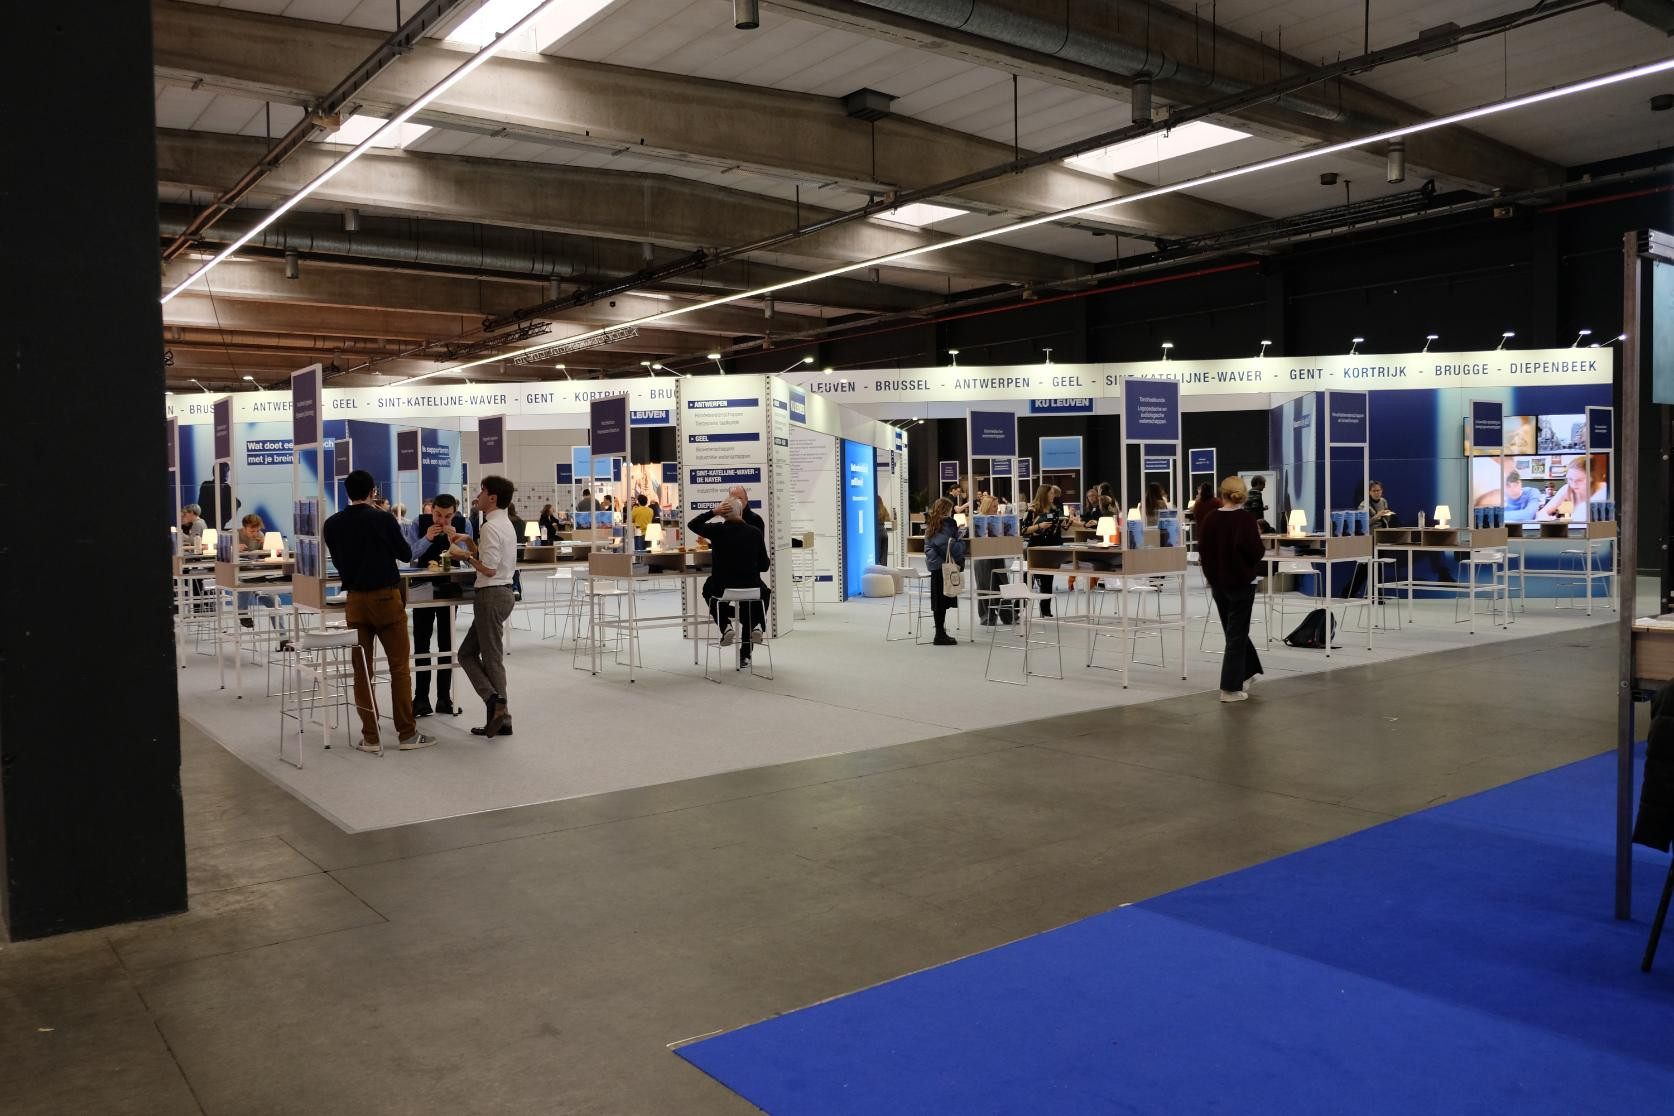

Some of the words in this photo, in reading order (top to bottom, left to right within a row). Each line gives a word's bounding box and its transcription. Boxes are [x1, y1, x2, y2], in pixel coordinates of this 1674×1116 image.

[810, 380, 856, 394] LEUVEN
[875, 379, 932, 392] BRUSSEL
[954, 377, 1031, 390] ANTWERPEN
[1051, 376, 1083, 387] GEEL
[1105, 370, 1263, 386] SIIJNE-WAVER
[1289, 368, 1324, 380] GENT
[1342, 366, 1408, 379] KORTRIJK
[1435, 364, 1489, 376] BRUGGE
[1510, 360, 1597, 374] DIEPENBEEK
[189, 403, 214, 415] BRUS
[332, 398, 358, 409] GEEL
[377, 394, 507, 408] SINT-KATELIJNE-WAVER
[526, 392, 555, 404] GENT
[1035, 399, 1049, 408] KU
[1051, 399, 1090, 407] LEUVEN
[631, 410, 666, 419] LEUVEN
[247, 442, 263, 450] Wat
[264, 441, 284, 450] doet
[248, 456, 263, 464] met
[264, 454, 272, 465] je
